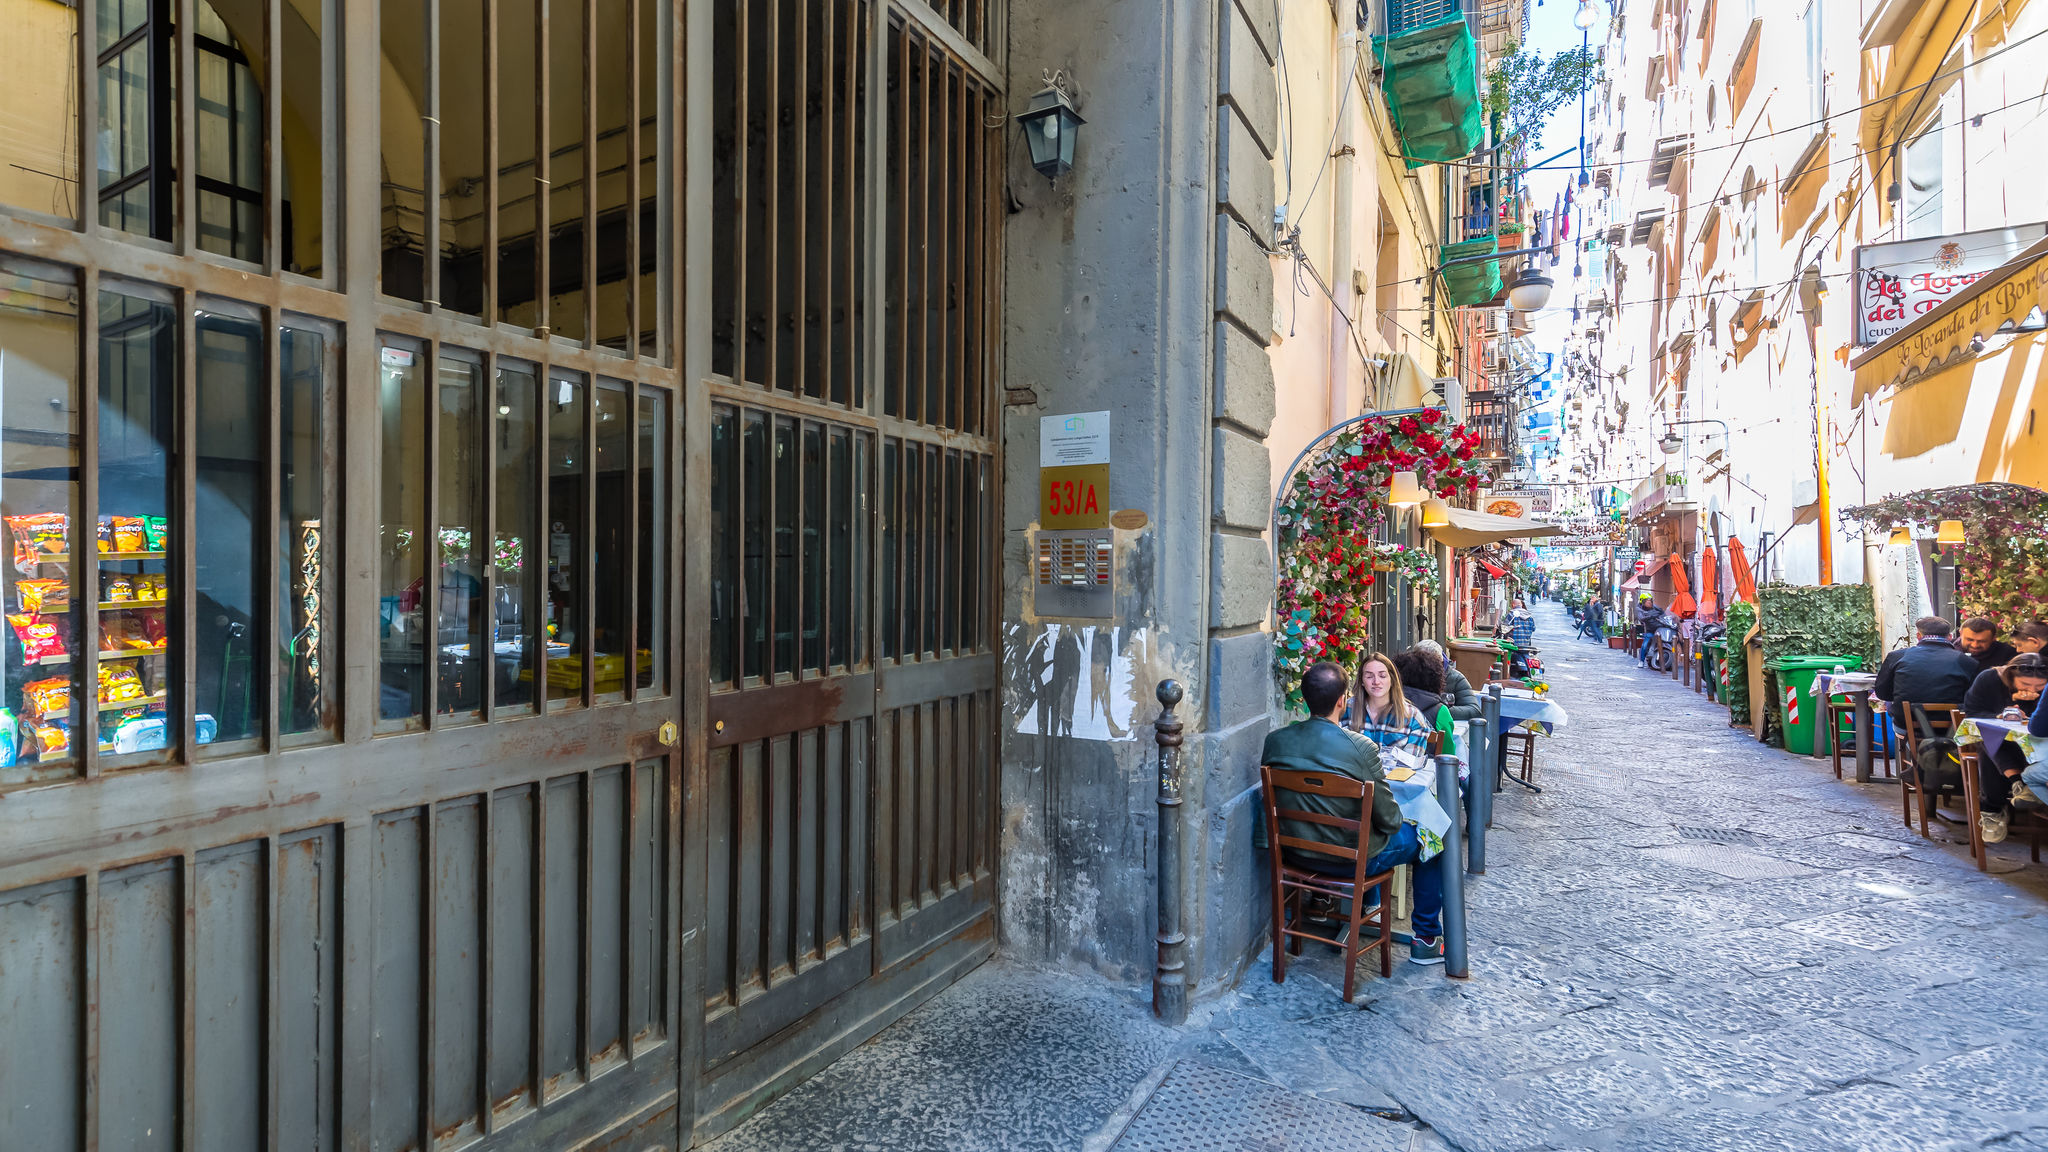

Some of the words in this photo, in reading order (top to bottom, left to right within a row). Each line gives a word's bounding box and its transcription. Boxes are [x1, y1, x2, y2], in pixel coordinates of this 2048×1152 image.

[1867, 278, 1906, 299] La
[1868, 303, 1905, 322] dei
[1050, 480, 1098, 515] 53/A
